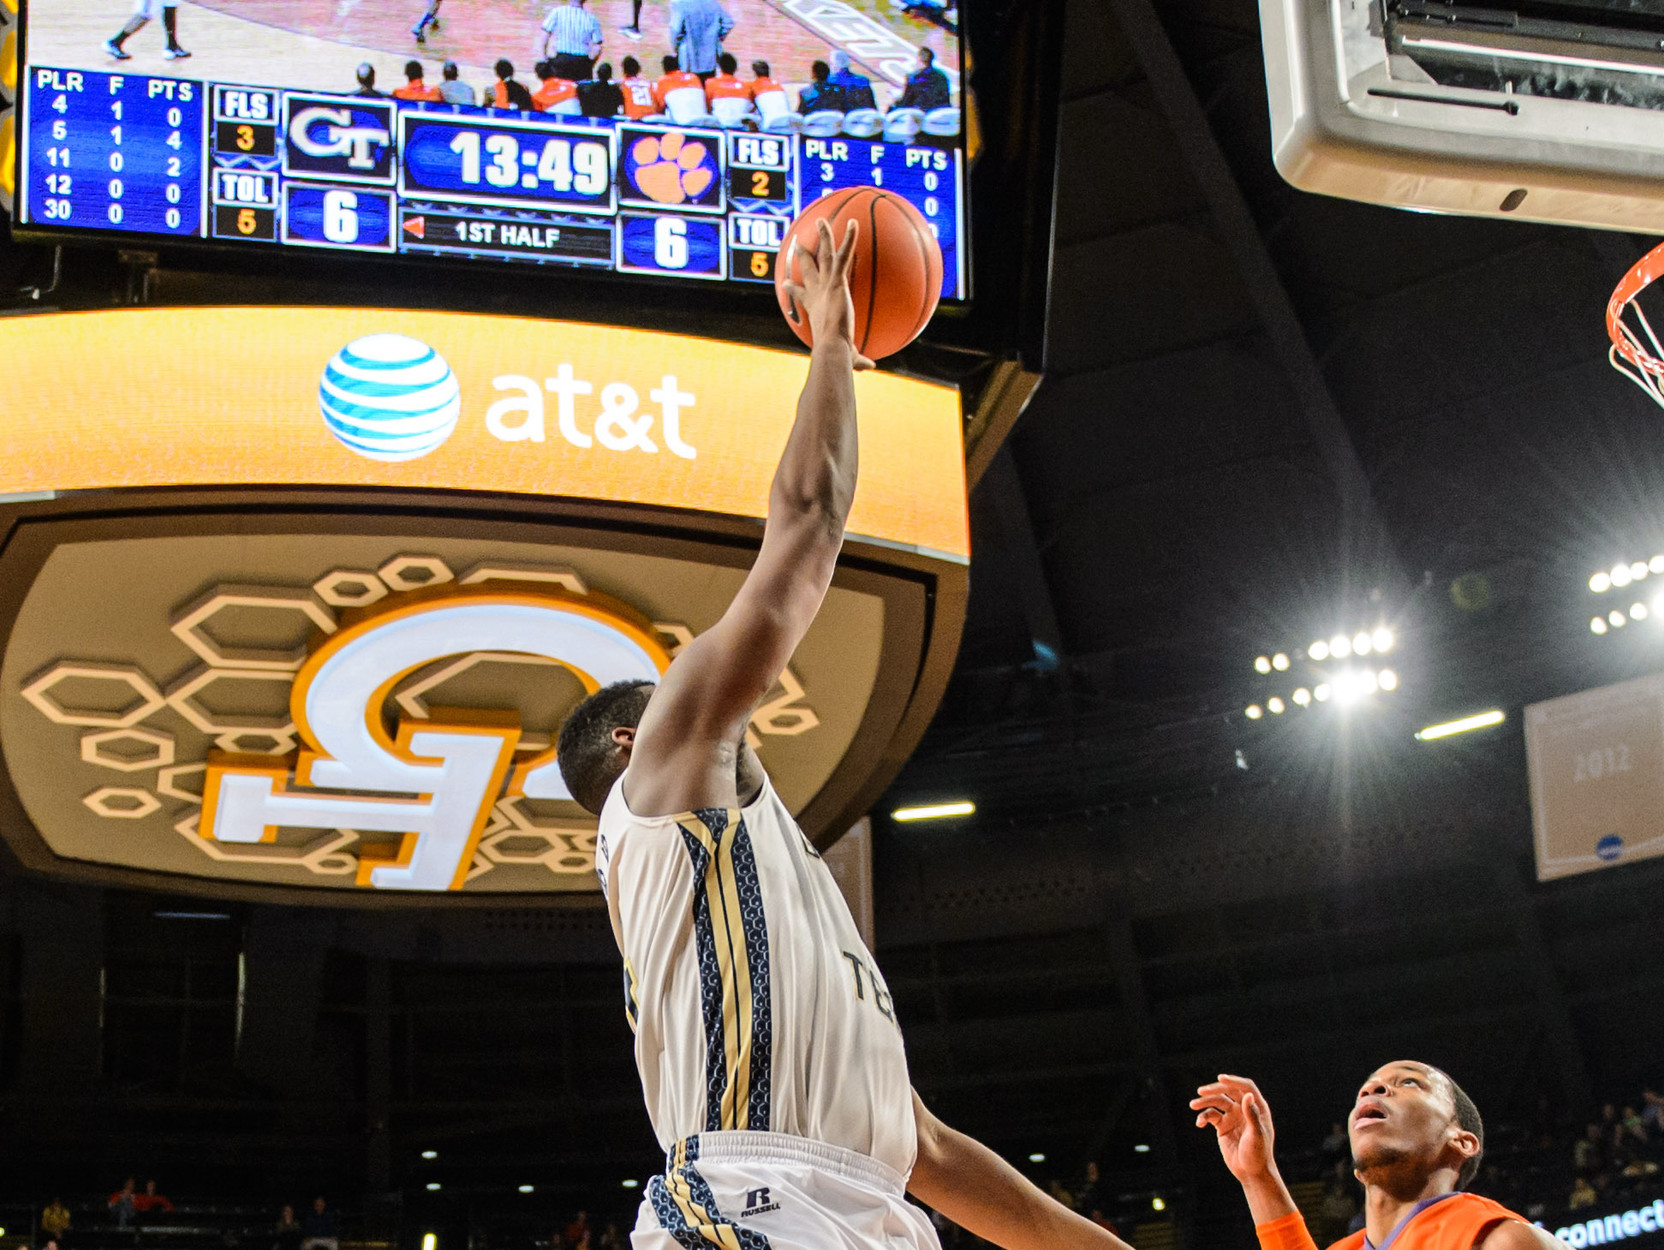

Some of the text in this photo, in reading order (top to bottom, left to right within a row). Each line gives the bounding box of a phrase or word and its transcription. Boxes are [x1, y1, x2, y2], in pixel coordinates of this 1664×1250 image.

[38, 69, 193, 102] PLR F PTS
[52, 94, 182, 127] 4 1 0
[225, 91, 268, 119] FLS
[52, 120, 182, 150] 5 1 4
[236, 125, 255, 151] 3
[46, 147, 181, 177] 11 0 2
[449, 131, 609, 196] 13:49
[738, 137, 780, 166] FLS
[805, 138, 948, 171] PLR F PTS
[45, 173, 181, 204] 12 0 0
[221, 173, 269, 204] TOL
[751, 171, 770, 197] 2
[820, 162, 939, 192] 3 1 0
[43, 198, 181, 229] 30 0 0
[236, 208, 257, 235] 5
[322, 189, 359, 243] 6
[924, 196, 939, 217] 0
[454, 220, 560, 248] 1ST HALF
[654, 216, 689, 269] 6
[737, 218, 781, 247] TOL
[750, 252, 769, 277] 5
[485, 362, 698, 460] at&t
[740, 1202, 782, 1218] RUSSELL
[1555, 1198, 1664, 1250] connect
